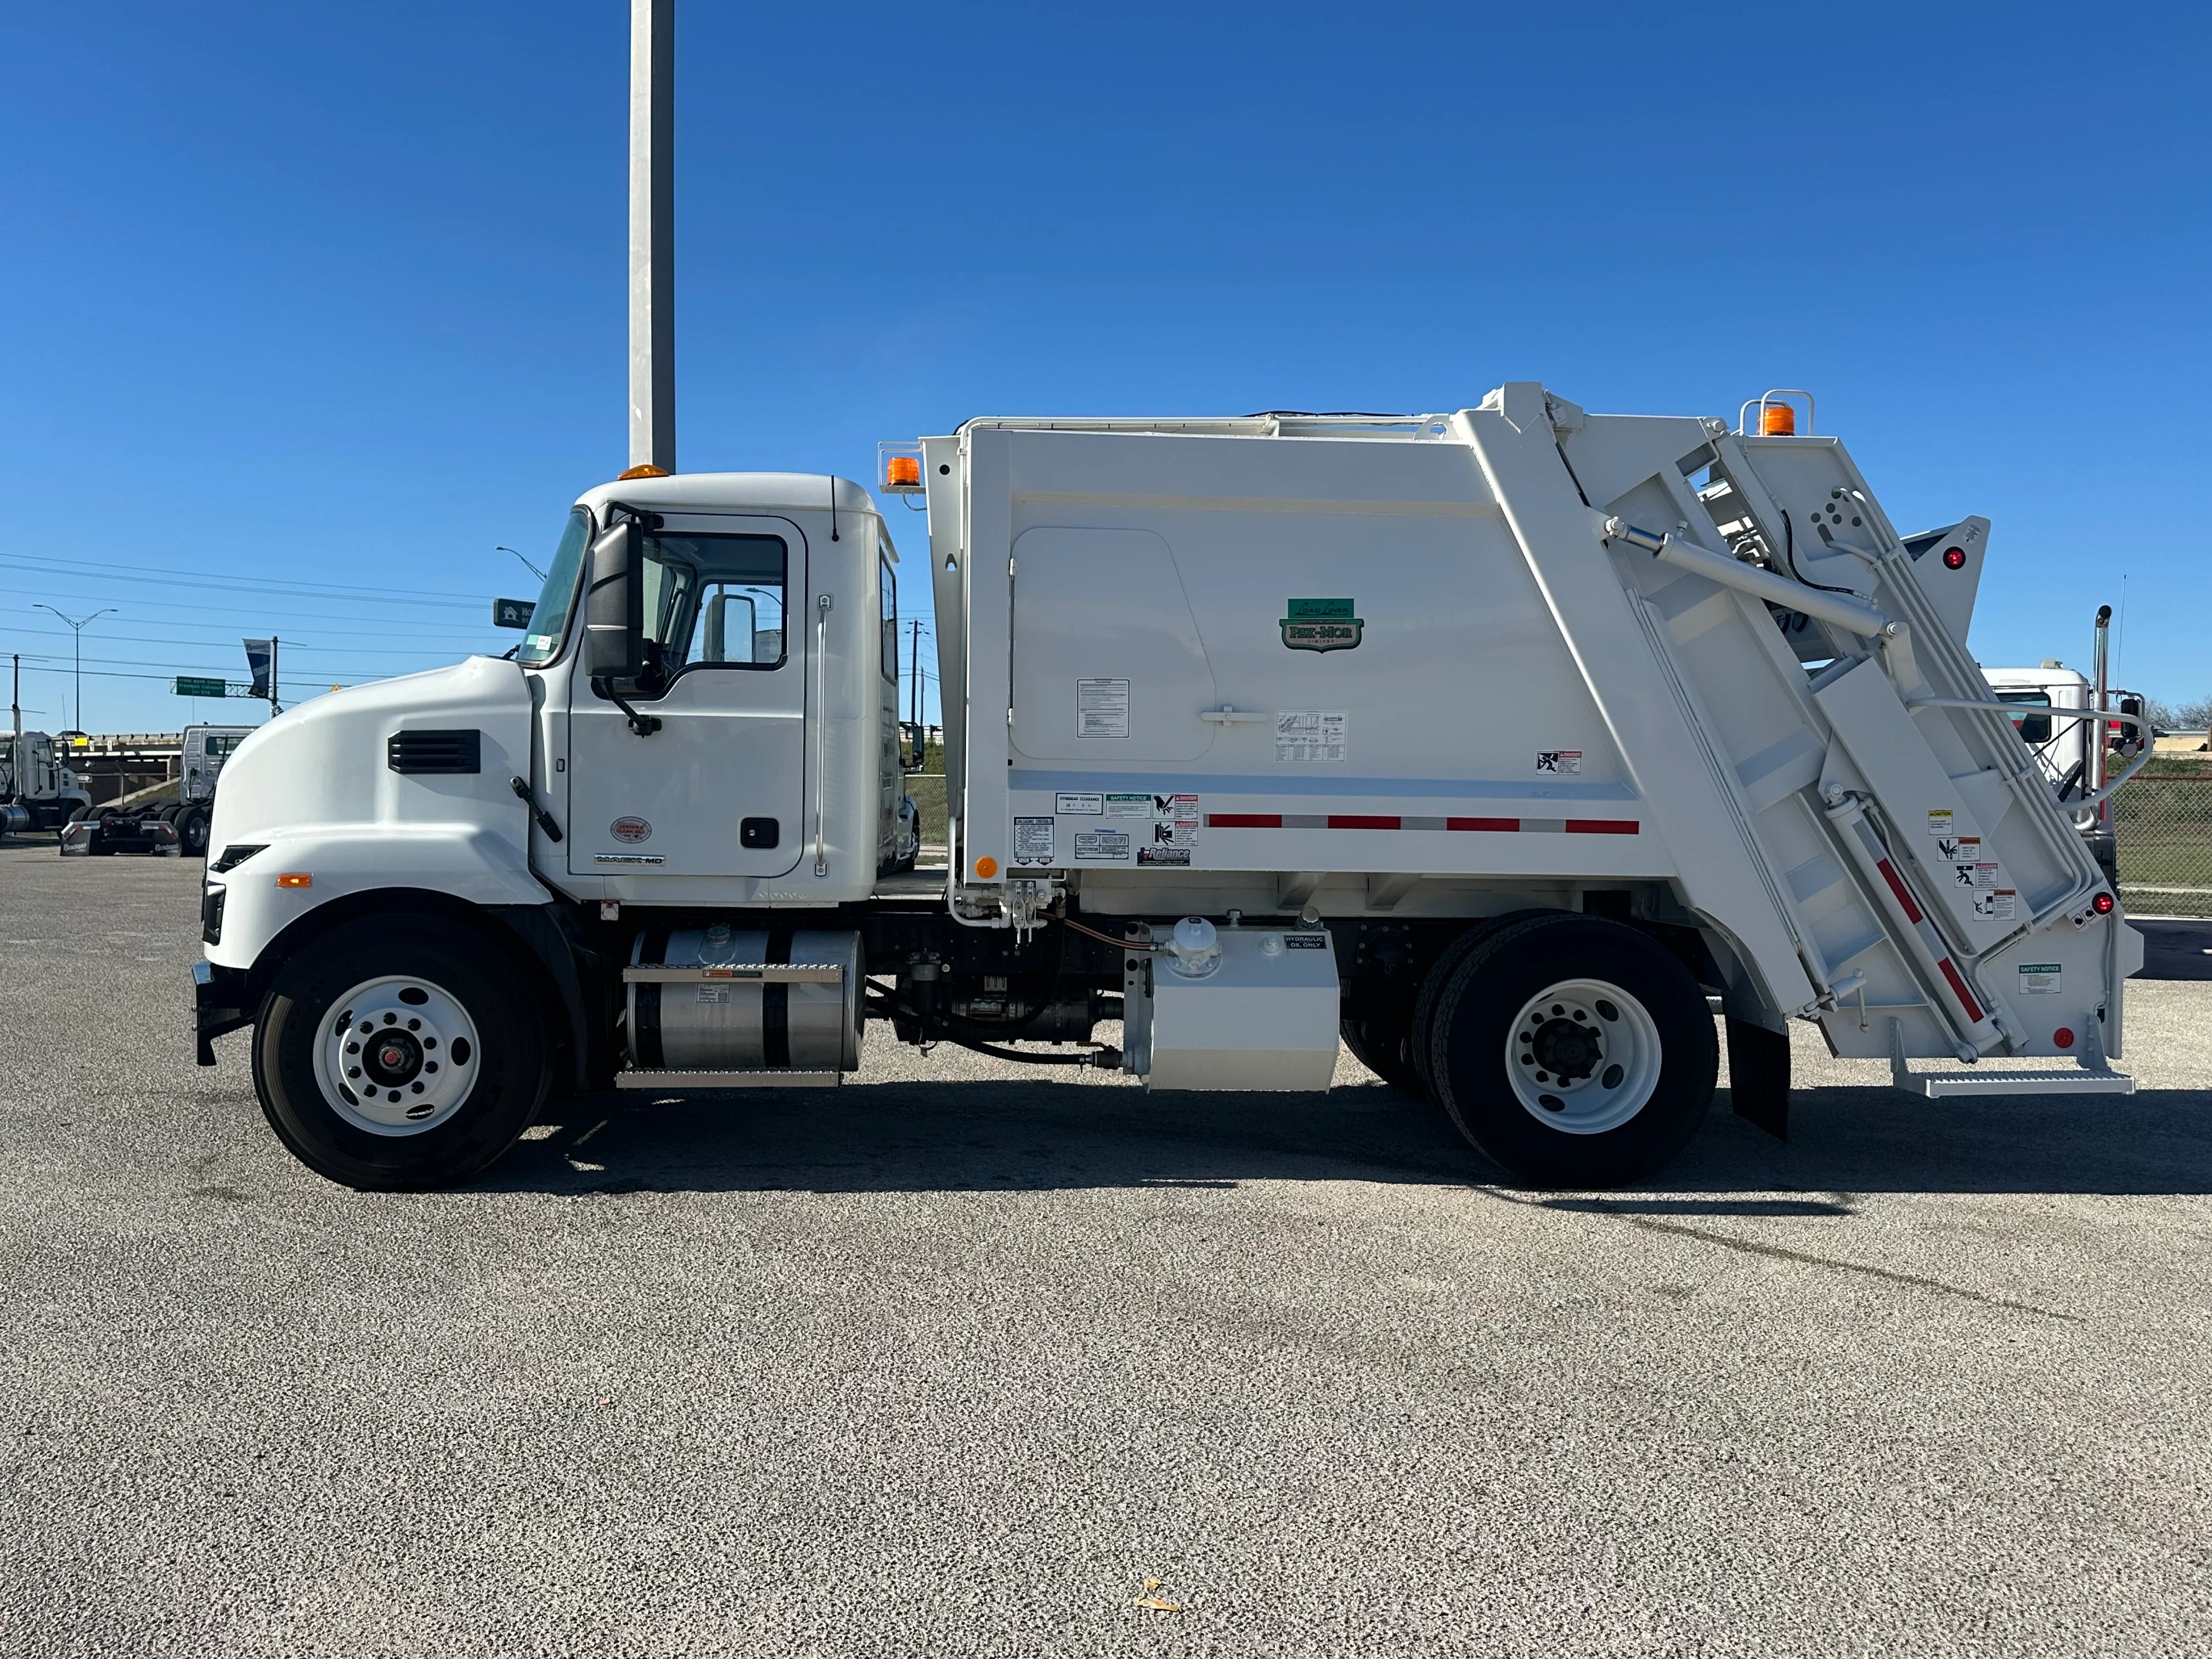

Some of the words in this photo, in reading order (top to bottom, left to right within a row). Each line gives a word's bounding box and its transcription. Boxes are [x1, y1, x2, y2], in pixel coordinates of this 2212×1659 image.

[1295, 602, 1321, 615] LOAD
[1321, 602, 1348, 615] LINER
[1289, 626, 1352, 639] PAK-MOR
[1149, 848, 1189, 858] Reliance
